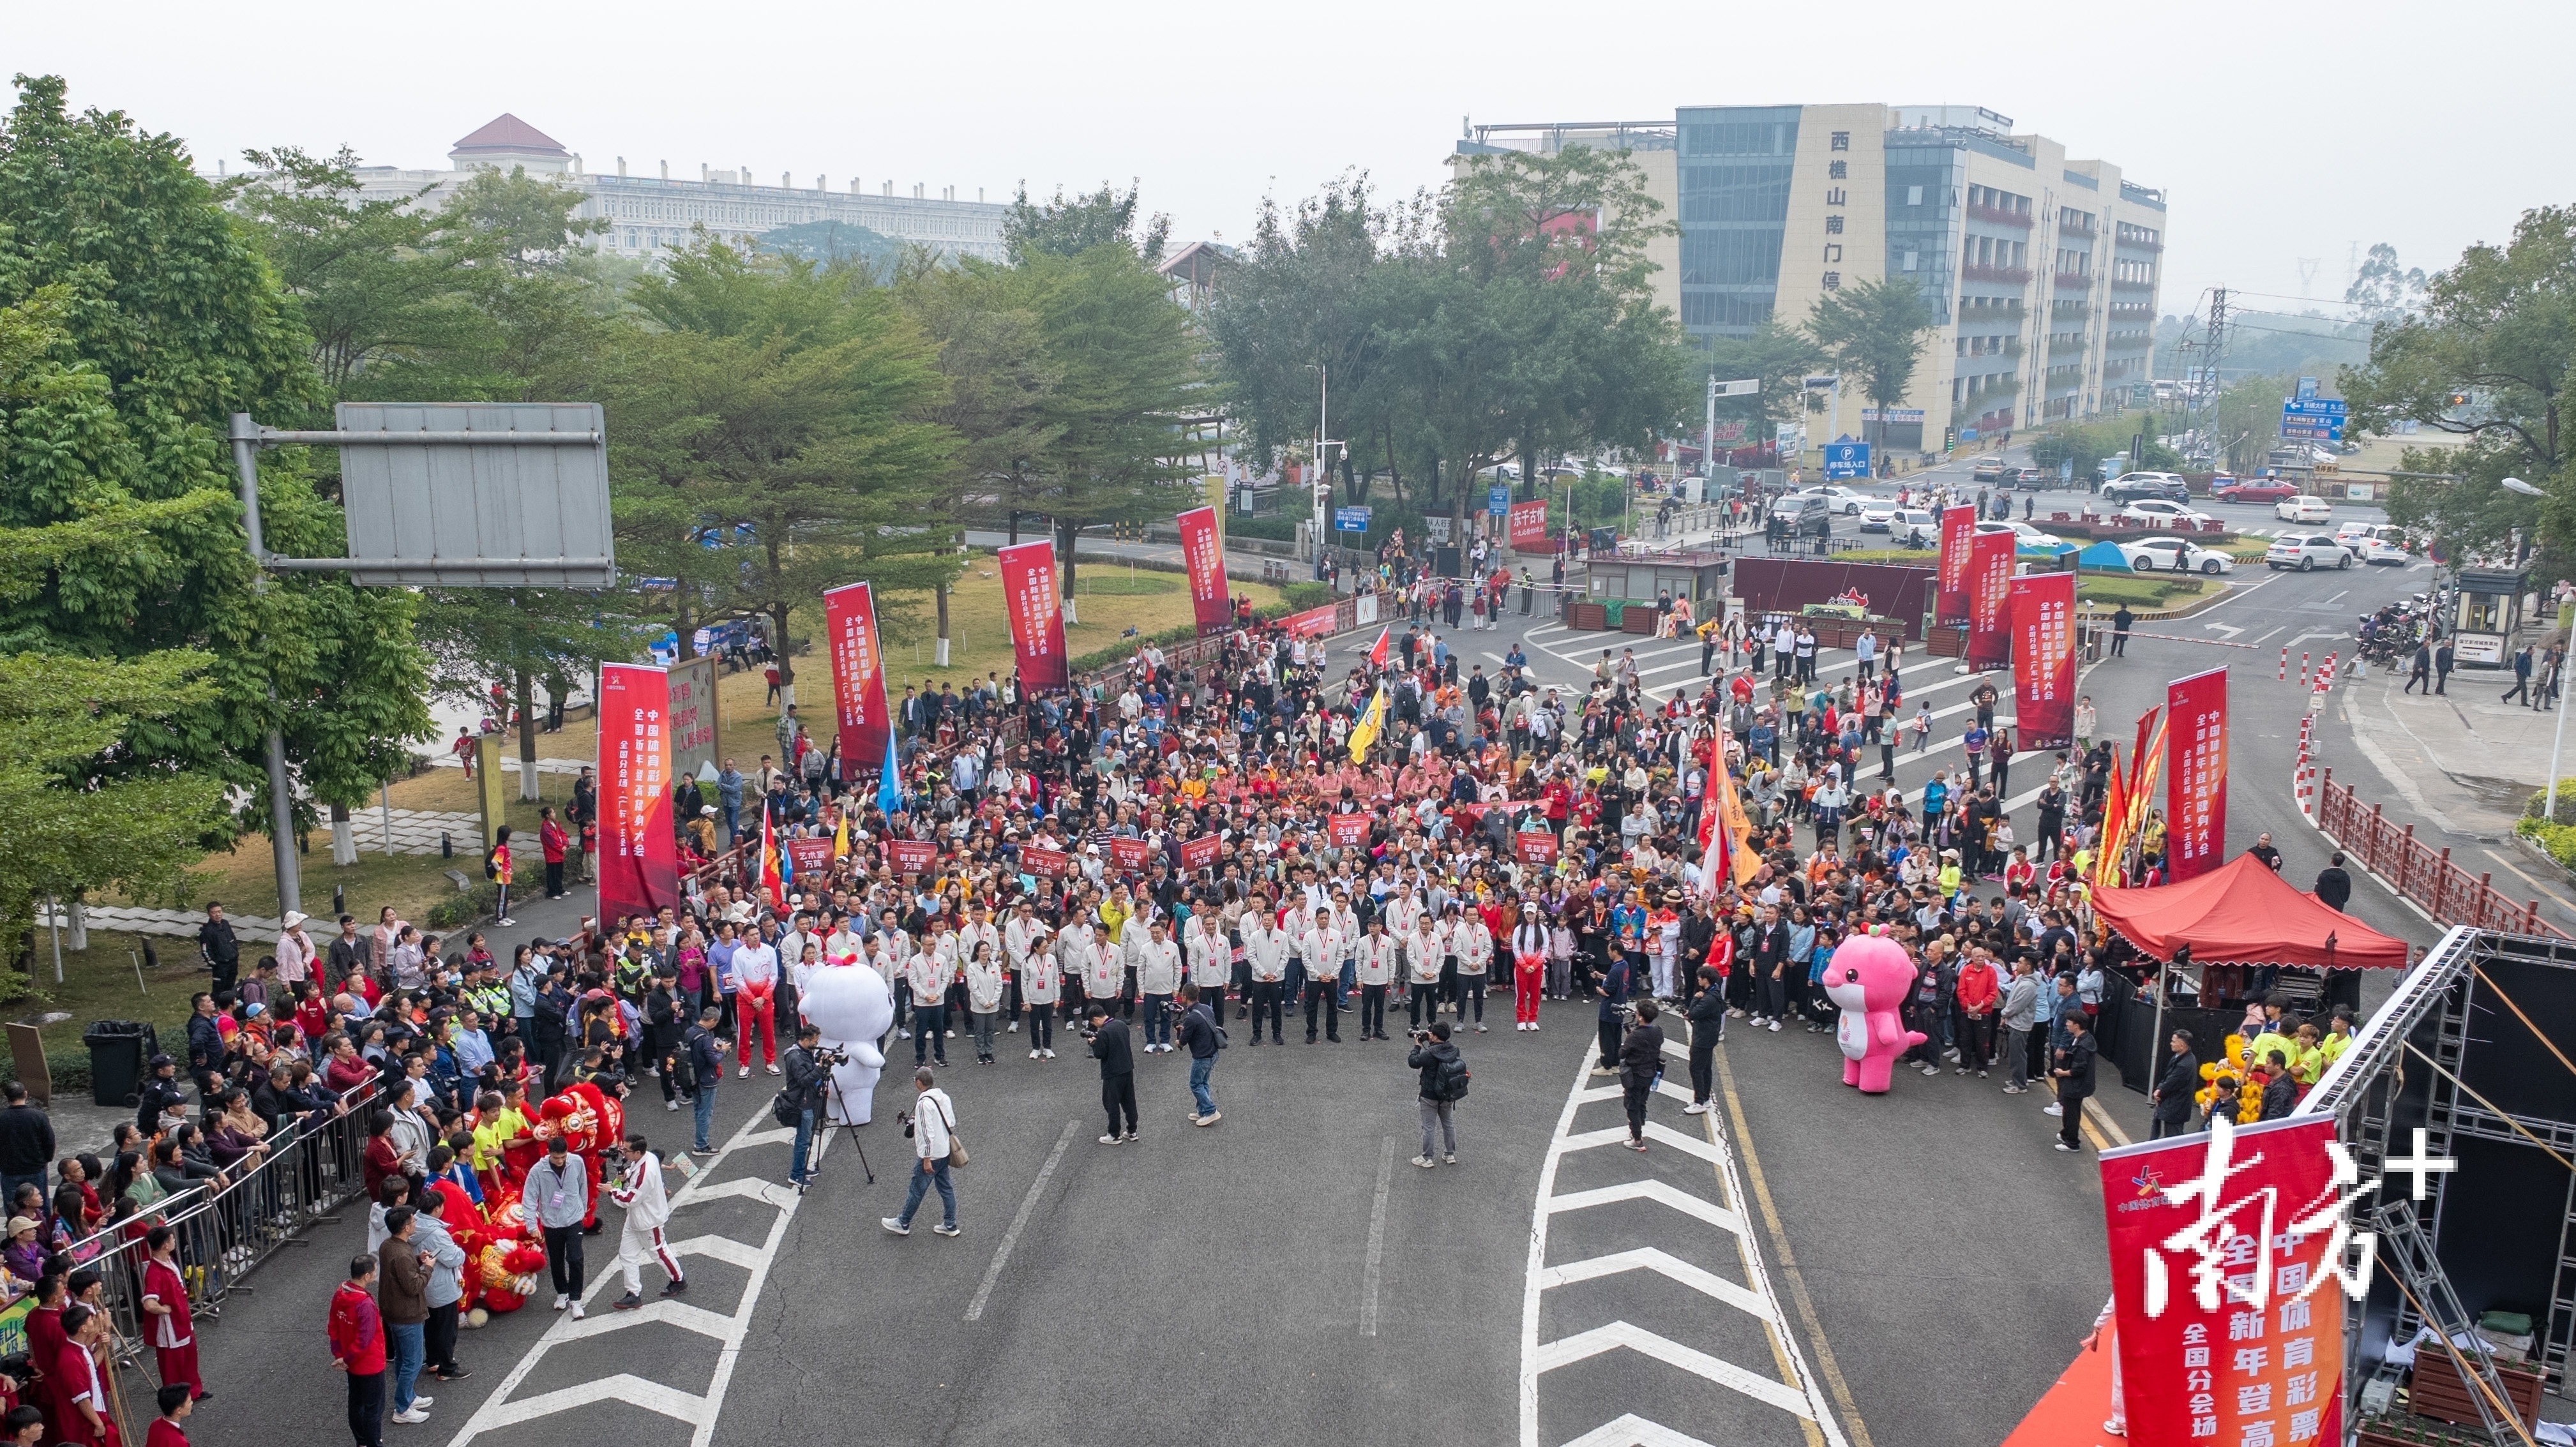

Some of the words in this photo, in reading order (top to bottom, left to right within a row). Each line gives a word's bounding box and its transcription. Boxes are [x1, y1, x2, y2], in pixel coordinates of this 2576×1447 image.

[1822, 131, 1849, 291] 西樵山南门停
[1830, 461, 1865, 469] 停车场入口
[1038, 566, 1053, 619] 中国体育彩票
[1027, 568, 1048, 656] 全国新年登高健身大会
[2053, 601, 2066, 660] 中国体育彩票
[854, 615, 871, 680] 中国体育彩票
[2040, 602, 2054, 700] 全国新年登高健身大会
[845, 617, 865, 725] 全国新年登高健身大会
[647, 709, 661, 798] 中国体育彩票
[2208, 710, 2220, 795] 中国体育彩票
[634, 708, 645, 857] 全国新年登高健身大会
[2196, 714, 2209, 857] 全国新年登高健身大会
[1337, 827, 1362, 836] 企业家
[1341, 836, 1358, 844] 方阵
[799, 850, 825, 861] 艺术家
[1119, 850, 1141, 860] 老干部
[1190, 847, 1214, 860] 科学家
[1525, 844, 1549, 854] 区旅游
[804, 859, 823, 869] 方阵
[900, 853, 927, 863] 教育家
[1027, 857, 1061, 870] 青年人才
[1123, 858, 1139, 868] 方阵
[1194, 857, 1211, 867] 方阵
[1528, 853, 1546, 863] 协会
[903, 862, 923, 871] 方阵
[1034, 866, 1052, 876] 方阵
[2223, 1234, 2275, 1447] 全国新年登高
[2272, 1227, 2319, 1443] 中国体育彩票
[2182, 1323, 2217, 1437] 全国分会场
